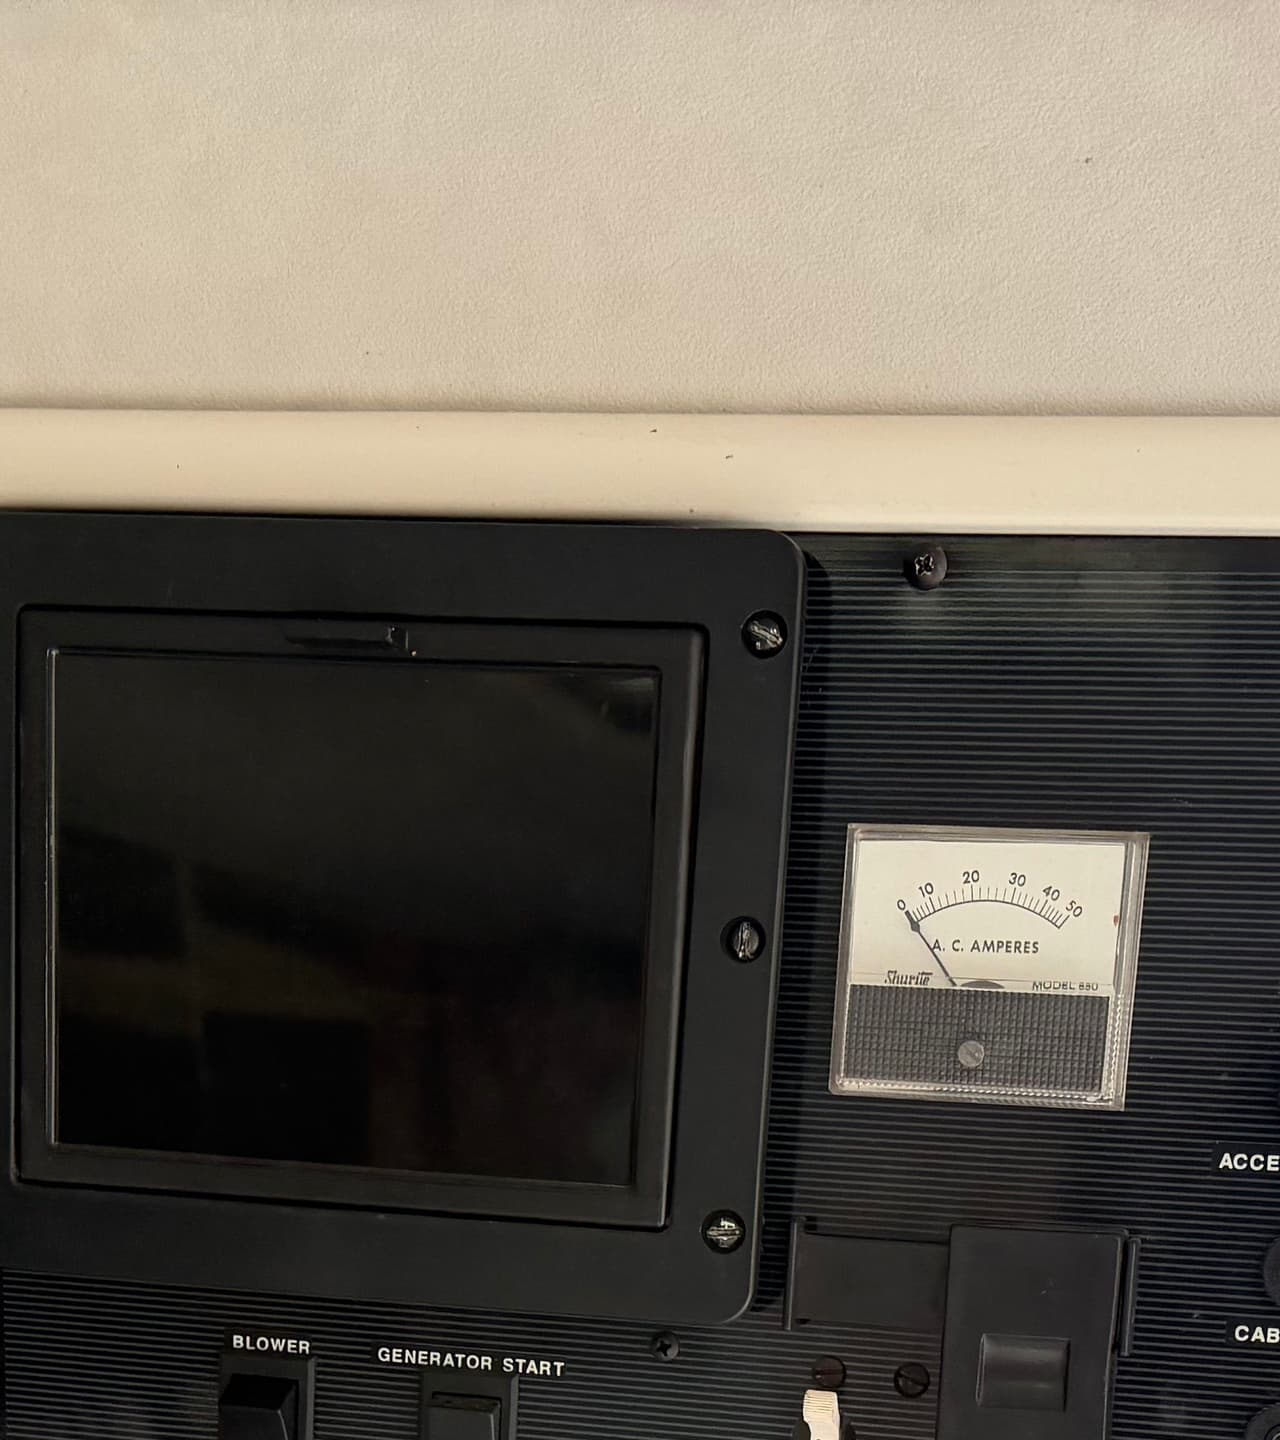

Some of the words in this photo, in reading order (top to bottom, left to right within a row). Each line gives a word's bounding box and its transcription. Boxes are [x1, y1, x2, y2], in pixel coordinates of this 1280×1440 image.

[962, 870, 980, 884] 20
[1009, 873, 1026, 887] 30
[918, 882, 935, 897] 10
[1042, 885, 1060, 902] 40
[896, 899, 907, 911] 0
[1065, 899, 1083, 918] 50
[951, 940, 964, 952] C.
[970, 940, 1040, 955] AMPERES
[1032, 980, 1076, 992] MODEL
[232, 1335, 311, 1354] BLOWER
[377, 1347, 493, 1370] GENERATOR
[503, 1358, 566, 1377] START
